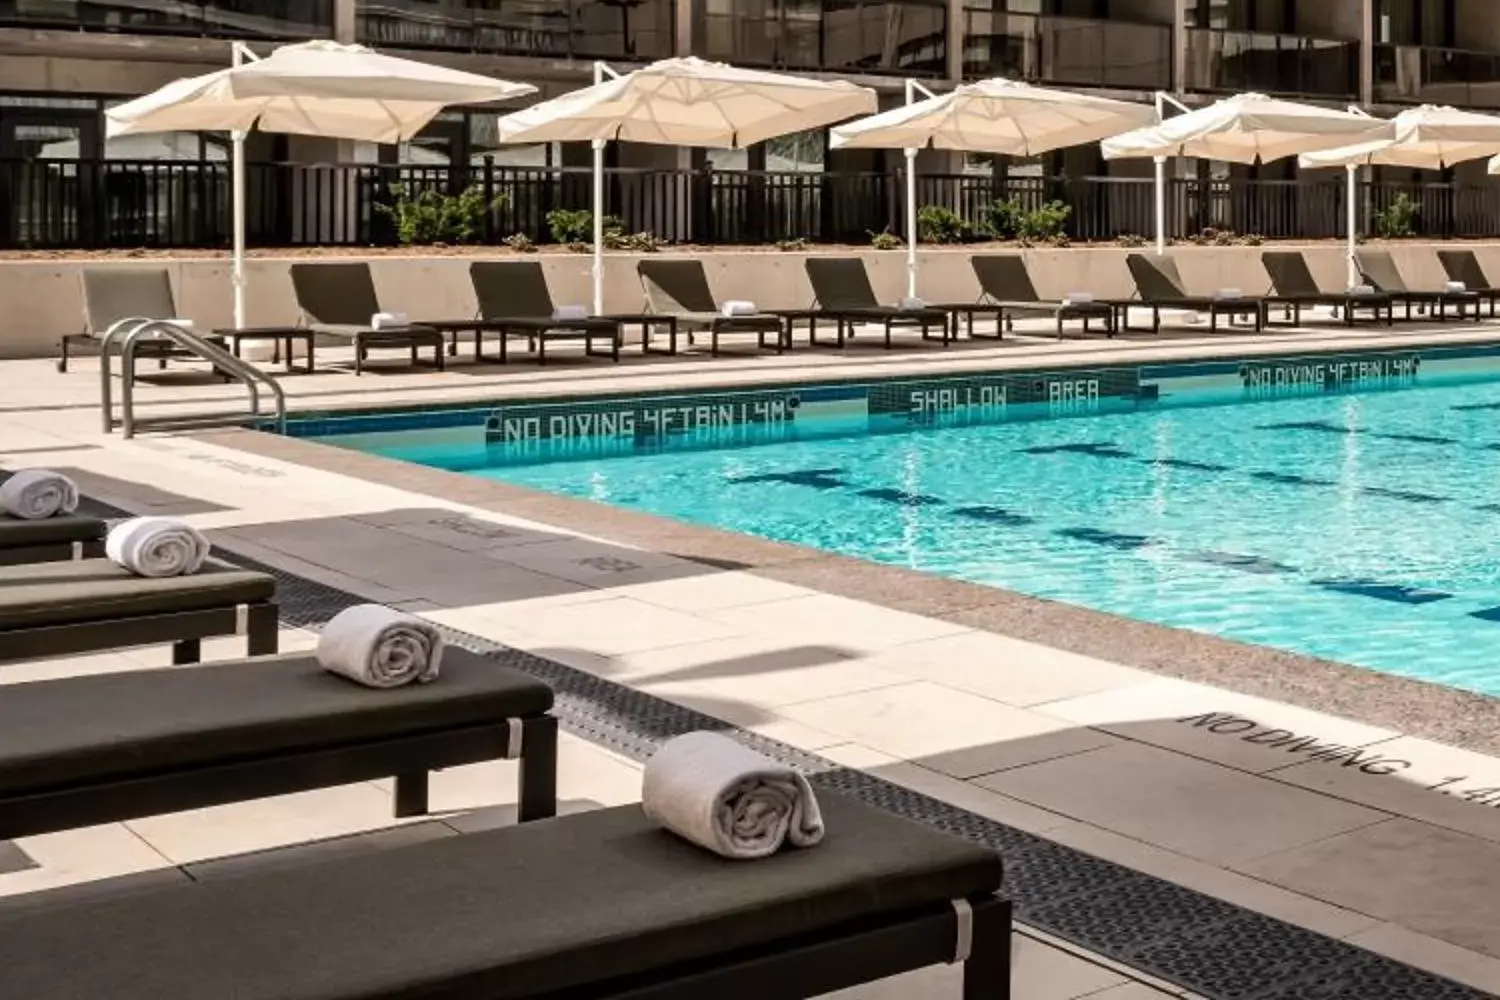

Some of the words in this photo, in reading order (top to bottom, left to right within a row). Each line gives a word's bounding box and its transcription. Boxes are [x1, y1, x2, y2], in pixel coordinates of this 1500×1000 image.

[1250, 367, 1270, 386] NO
[1276, 365, 1325, 384] DIVING
[911, 386, 1006, 412] SHALLOW
[1050, 379, 1099, 401] AREA
[503, 417, 540, 441] NO
[550, 411, 635, 438] DIVING
[1176, 712, 1257, 734] NO
[1240, 729, 1412, 775] DIVING
